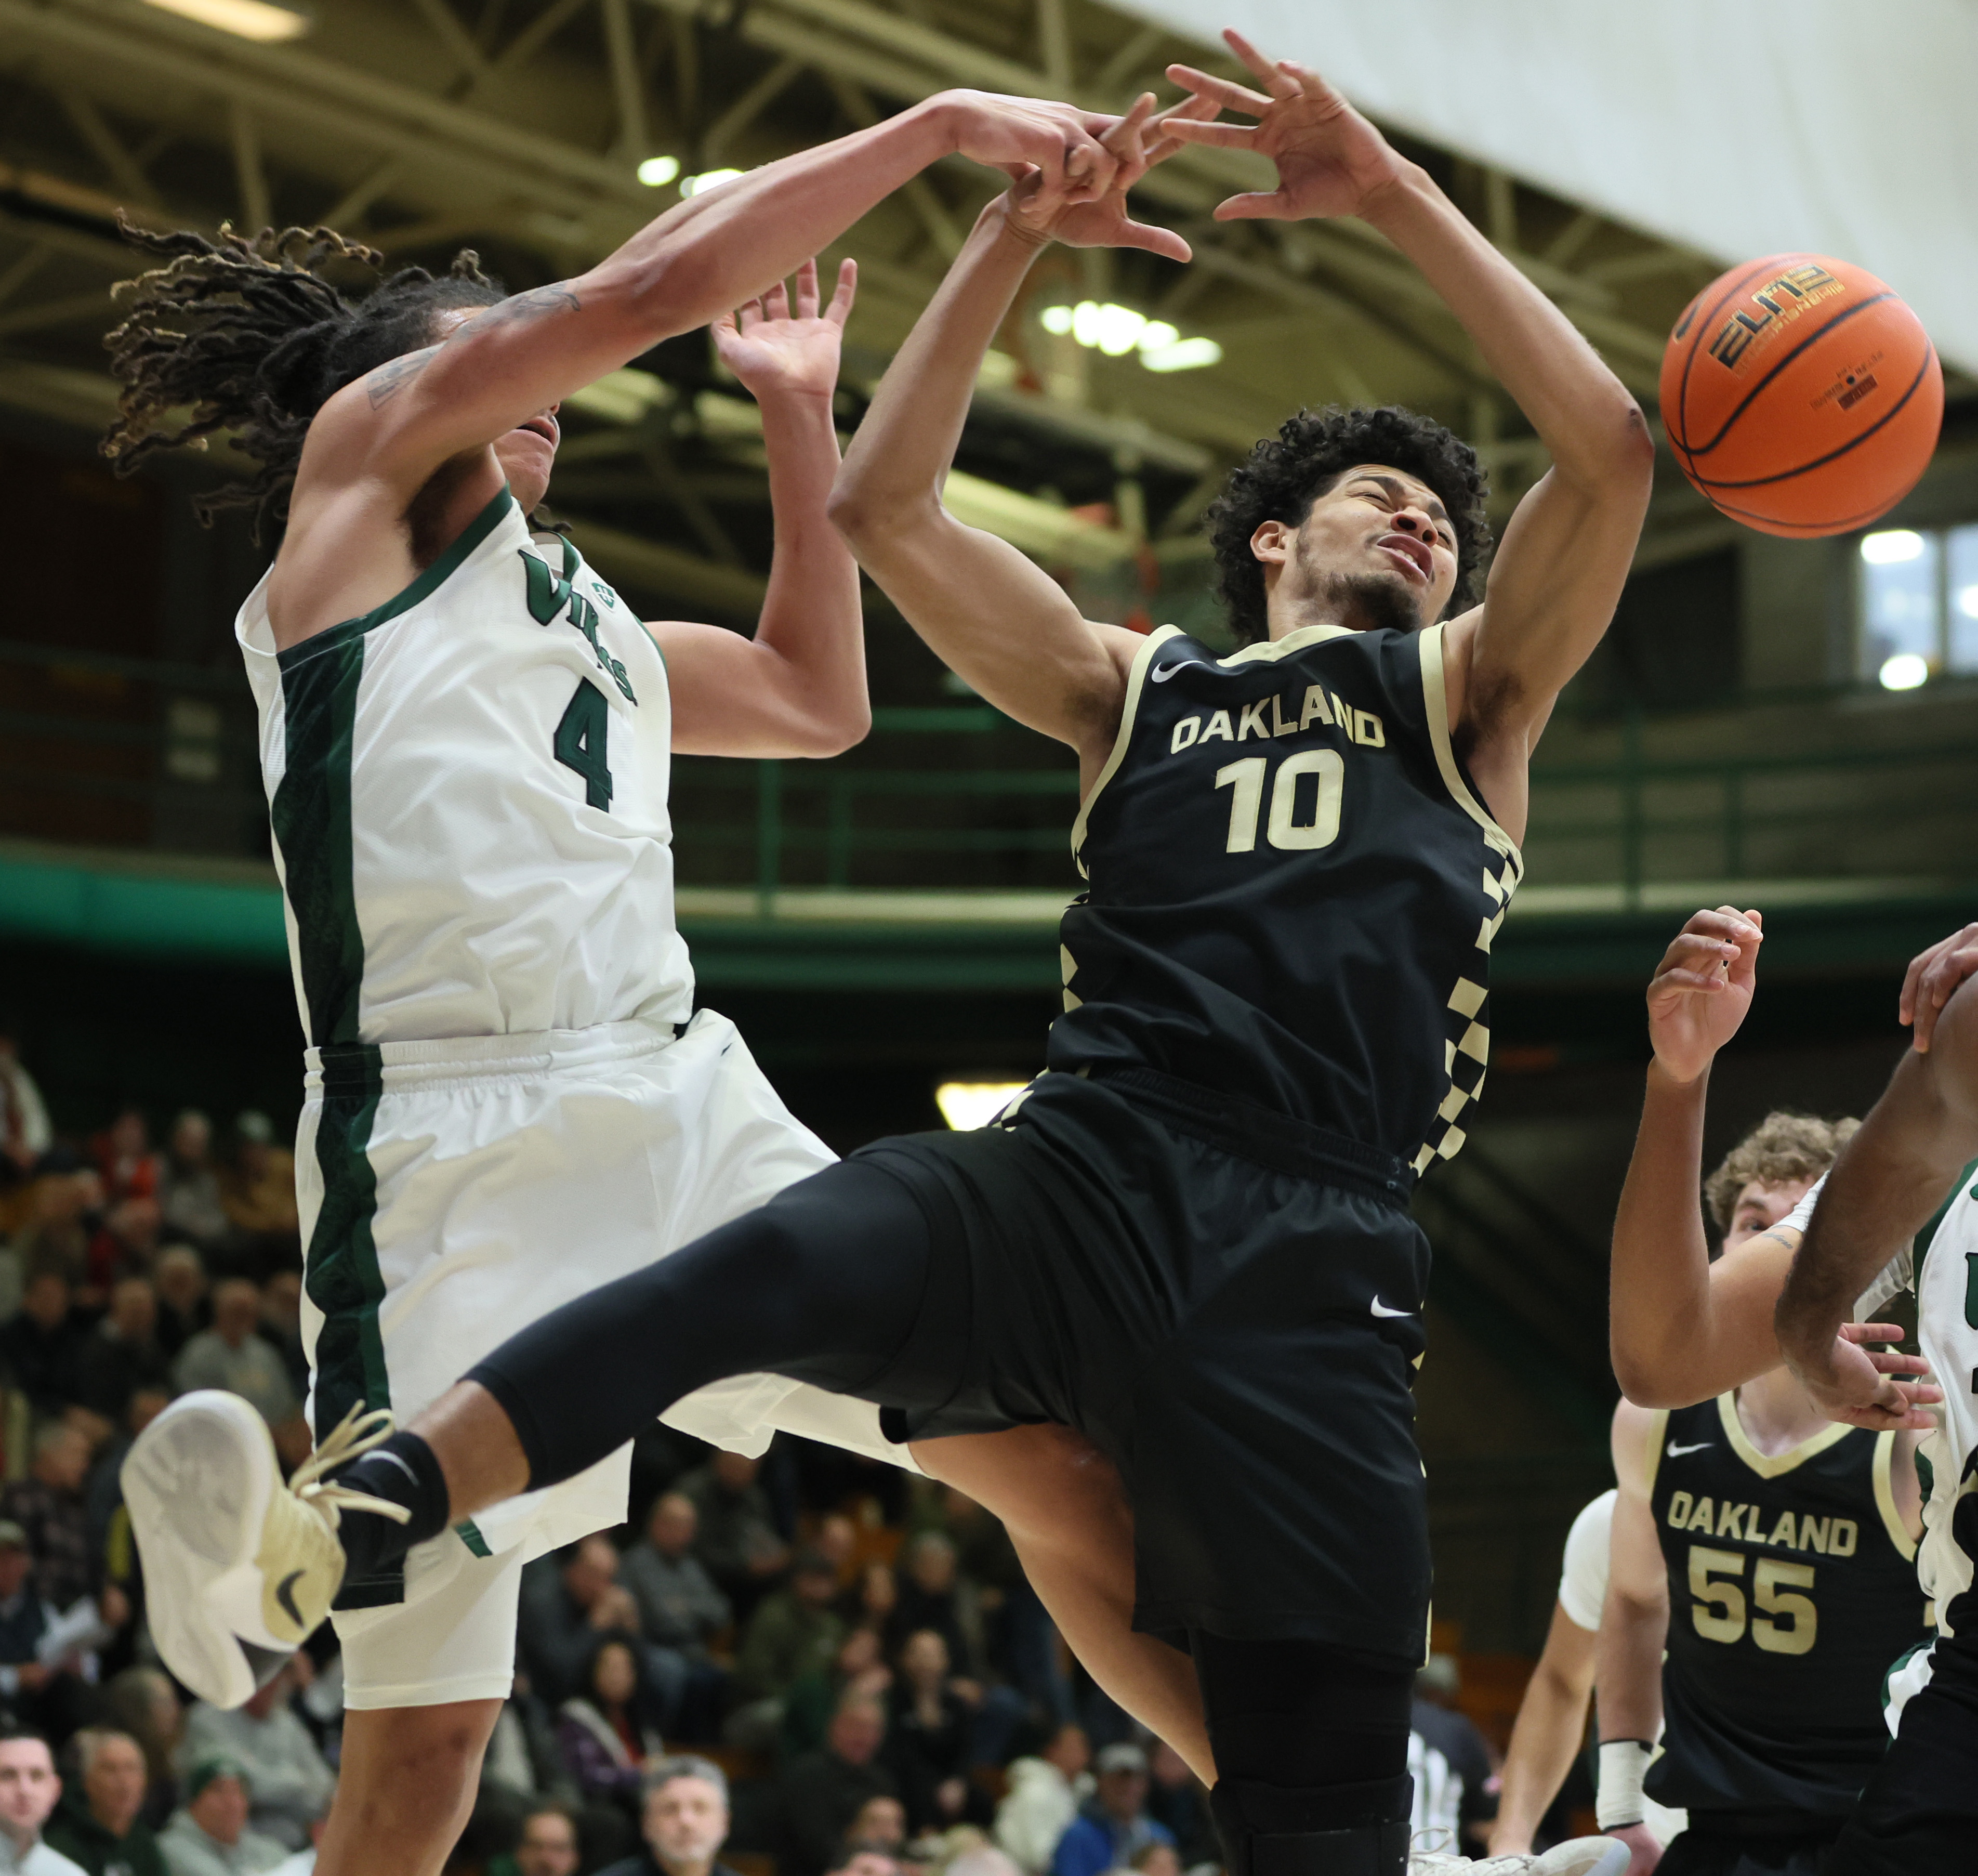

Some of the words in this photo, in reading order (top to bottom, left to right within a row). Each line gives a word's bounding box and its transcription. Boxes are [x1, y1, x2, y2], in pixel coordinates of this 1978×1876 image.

[1708, 263, 1840, 370] ELITE
[553, 676, 613, 814] 4
[1170, 685, 1386, 754] OAKLAND
[1215, 749, 1344, 853] 10
[1667, 1490, 1858, 1557] OAKLAND
[1687, 1545, 1817, 1655] 55
